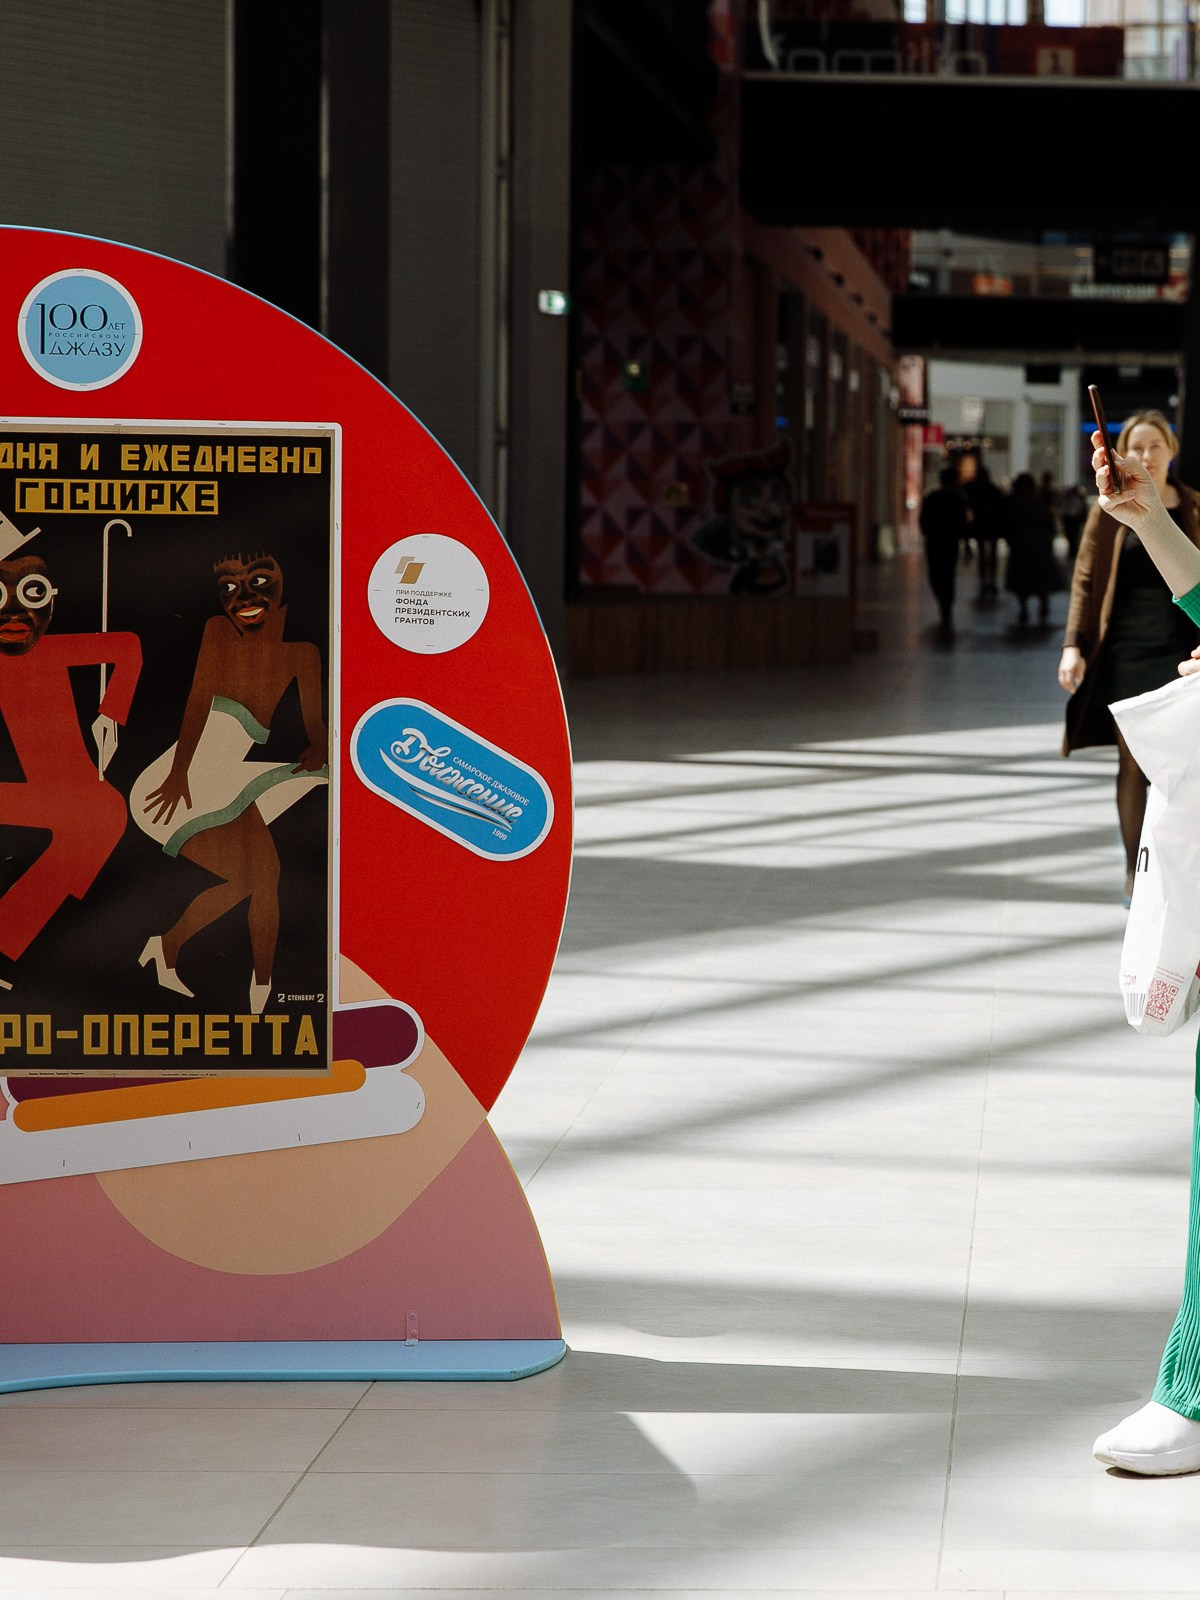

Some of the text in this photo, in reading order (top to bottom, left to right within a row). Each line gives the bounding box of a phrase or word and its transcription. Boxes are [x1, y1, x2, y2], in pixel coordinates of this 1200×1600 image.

[36, 303, 126, 355] 100 ЛЕТ
[48, 332, 126, 340] РОССИЙСКОМУ
[48, 341, 126, 357] ДЖАЗУ
[81, 443, 100, 471] И
[121, 444, 322, 474] ЕЖЕДНЕВНО
[19, 480, 216, 513] ГОСЦИРКЕ
[411, 590, 453, 598] ПОДДЕРЖКЕ
[395, 598, 429, 606] ФОНДА
[395, 607, 471, 618] ПРЕЗИДЕНТСКИХ
[394, 617, 435, 625] ГРАНТОВ
[390, 727, 524, 824] Движение
[453, 756, 530, 806] САМАРСКОЕ ДЖАЗОВОЕ
[492, 828, 508, 841] 1999
[277, 993, 286, 1003] 2
[317, 993, 325, 1003] 2
[0, 1014, 319, 1055] РО-ОПЕРЕТТА
